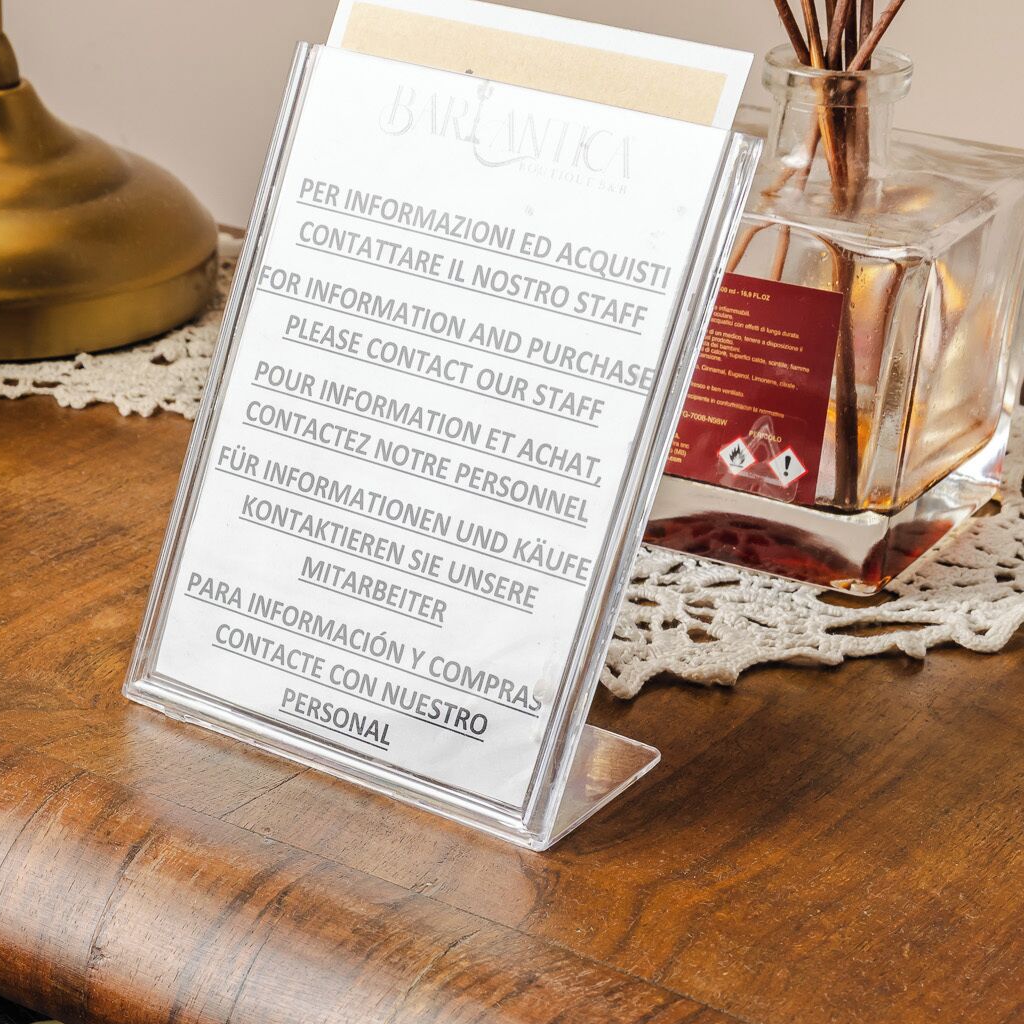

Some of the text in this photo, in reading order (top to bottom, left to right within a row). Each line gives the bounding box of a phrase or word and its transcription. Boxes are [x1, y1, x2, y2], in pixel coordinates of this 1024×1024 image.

[299, 177, 672, 291] PER INFORMAZIONI ED ACQUISTI
[299, 221, 649, 330] CONTATTARE IL NOSTRO STAFF
[258, 265, 655, 392] FOR INFORMATION AND PURCHASE
[285, 314, 605, 423] PLEASE CONTACT OUR STAFF
[246, 401, 590, 524] CONTACTEZ NOTRE PERSONNEL
[254, 360, 603, 486] POUR INFORMATION ET ACHAT,
[218, 444, 593, 582] FÜR INFORMATIONEN UND KÄUFE
[242, 494, 540, 609] KONTAKTIEREN SIE UNSERE
[187, 572, 543, 712] PARA INFORMACIÓN Y COMPRAS
[301, 556, 448, 623] MITARBEITER
[215, 623, 489, 736] CONTACTE CON NUESTRO
[281, 688, 390, 746] PERSONAL
